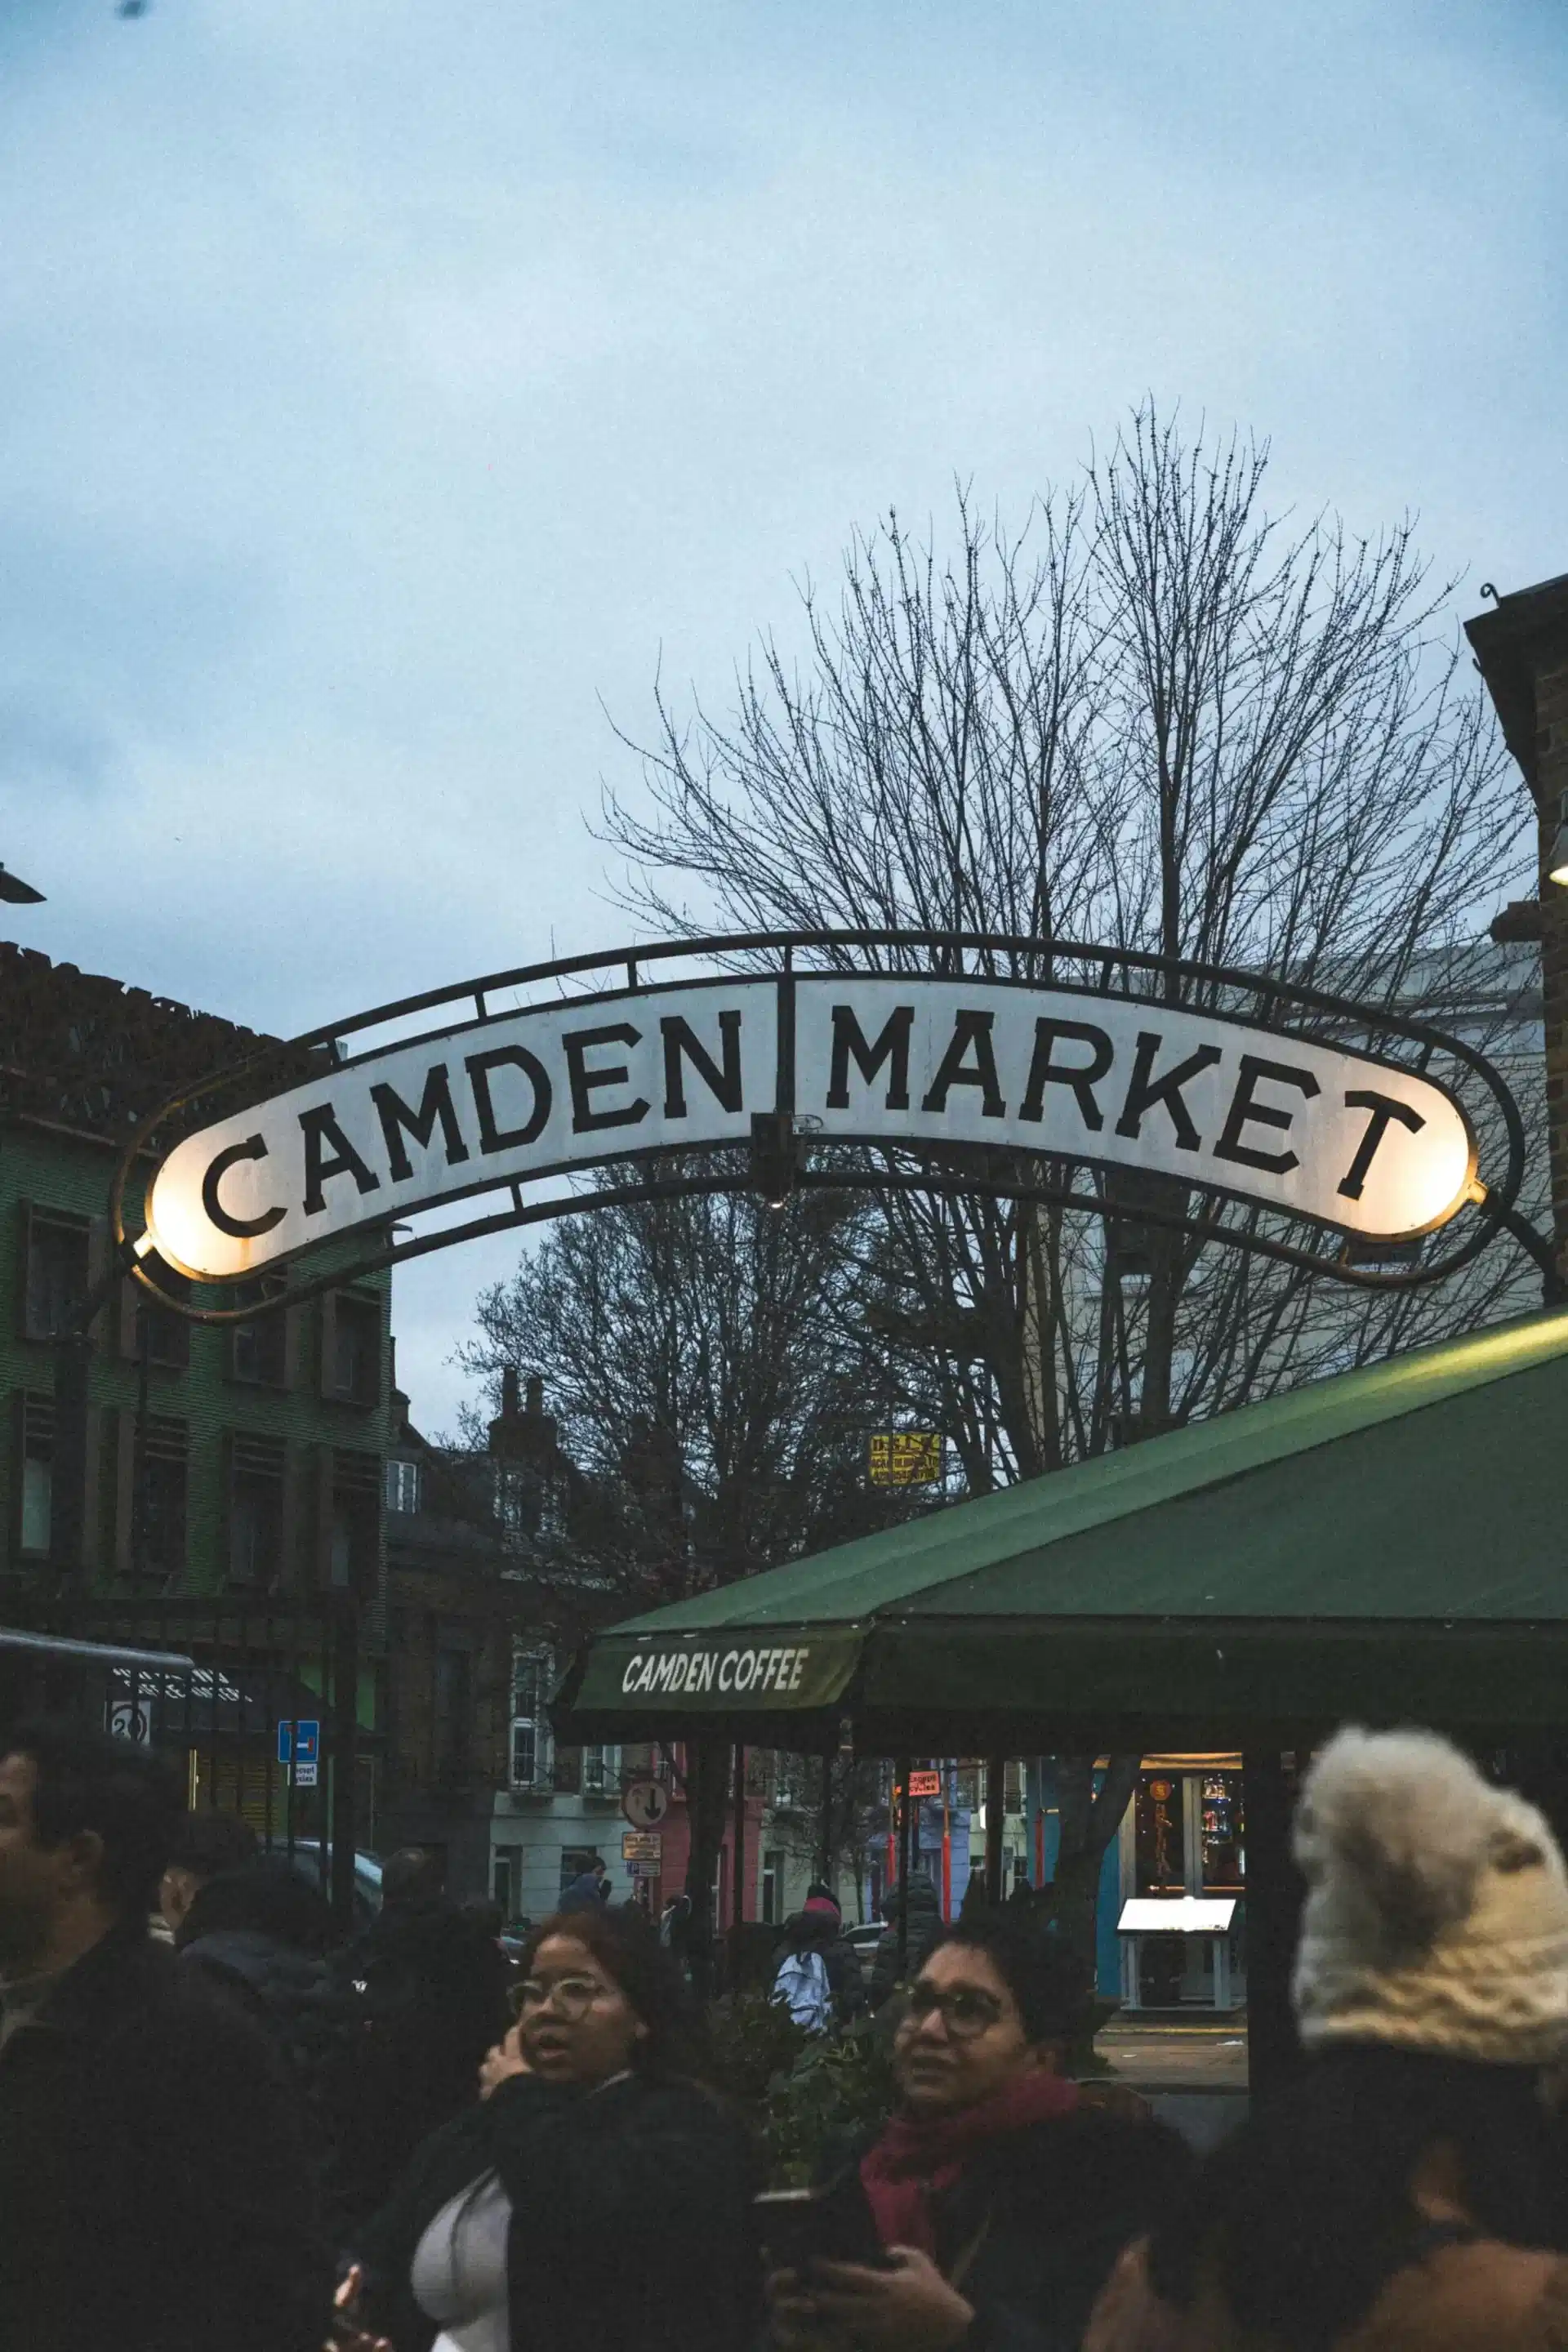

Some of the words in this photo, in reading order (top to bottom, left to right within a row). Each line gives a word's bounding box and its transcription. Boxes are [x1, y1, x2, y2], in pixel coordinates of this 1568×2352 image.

[202, 1009, 743, 1238] CAMDEN
[826, 1004, 1426, 1200] MARKET
[621, 1652, 719, 1693] CAMDEN
[718, 1648, 809, 1692] COFFEE
